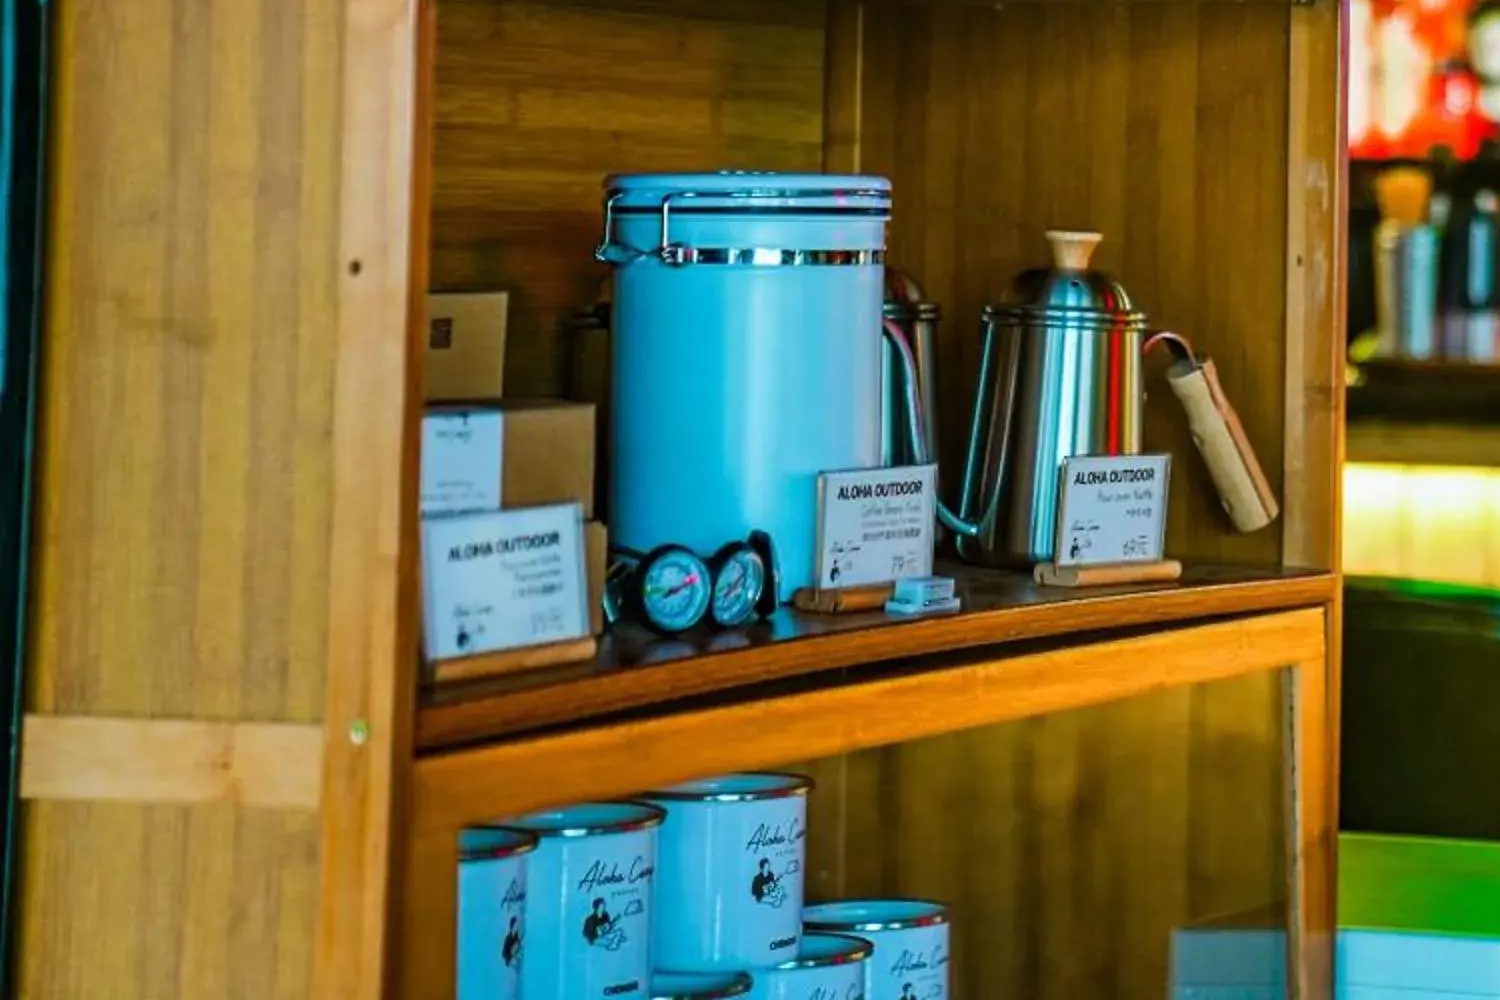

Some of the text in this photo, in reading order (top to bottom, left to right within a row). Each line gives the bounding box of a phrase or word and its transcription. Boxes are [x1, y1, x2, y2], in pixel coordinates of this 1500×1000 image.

[1074, 467, 1155, 485] ALOHA OUTDOOR
[838, 480, 923, 500] ALOHA OUTDOOR
[448, 543, 494, 562] ALOHA
[495, 530, 561, 555] OUTDOOR
